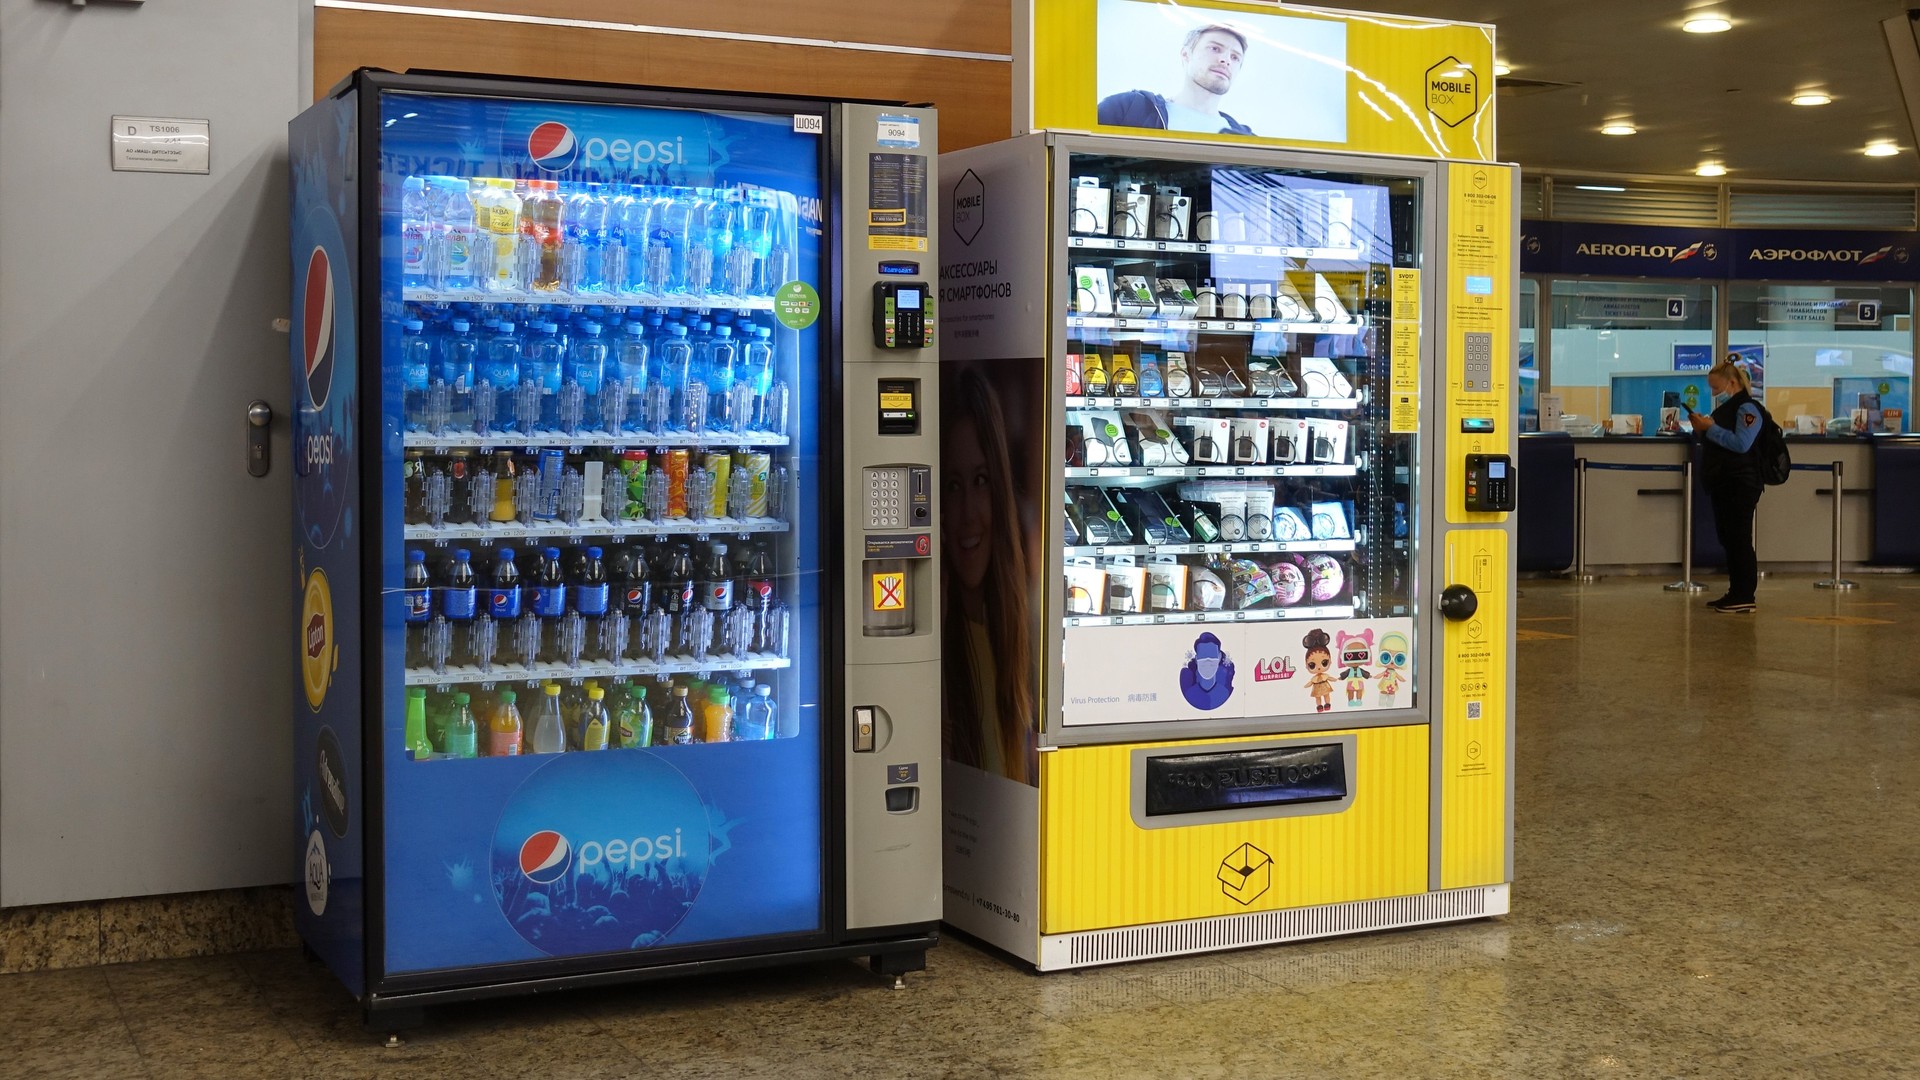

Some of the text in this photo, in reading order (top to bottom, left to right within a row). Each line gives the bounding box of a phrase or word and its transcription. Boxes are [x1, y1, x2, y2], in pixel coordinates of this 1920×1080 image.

[1431, 81, 1471, 94] MOBILE
[1431, 94, 1454, 104] BOX
[795, 116, 820, 130] Ш094
[128, 126, 137, 136] D
[585, 136, 684, 170] pepsi
[956, 195, 980, 209] MOBILE
[956, 212, 970, 223] BOX
[1576, 243, 1677, 258] AEROFLOT
[1750, 248, 1862, 262] АЭРОФЛОТ
[939, 260, 997, 280] АКСЕССУАРЫ
[946, 282, 1011, 302] СМАРТФОНОВ
[1672, 303, 1678, 313] 4
[1864, 307, 1871, 318] 5
[308, 426, 333, 474] pepsi
[308, 625, 324, 651] Lipton
[1260, 656, 1296, 674] LOL
[1088, 695, 1120, 704] Protection
[1127, 692, 1158, 702] 病毒防護
[1218, 766, 1283, 788] PUSH
[580, 827, 681, 874] pepsi
[310, 860, 324, 889] AQUA
